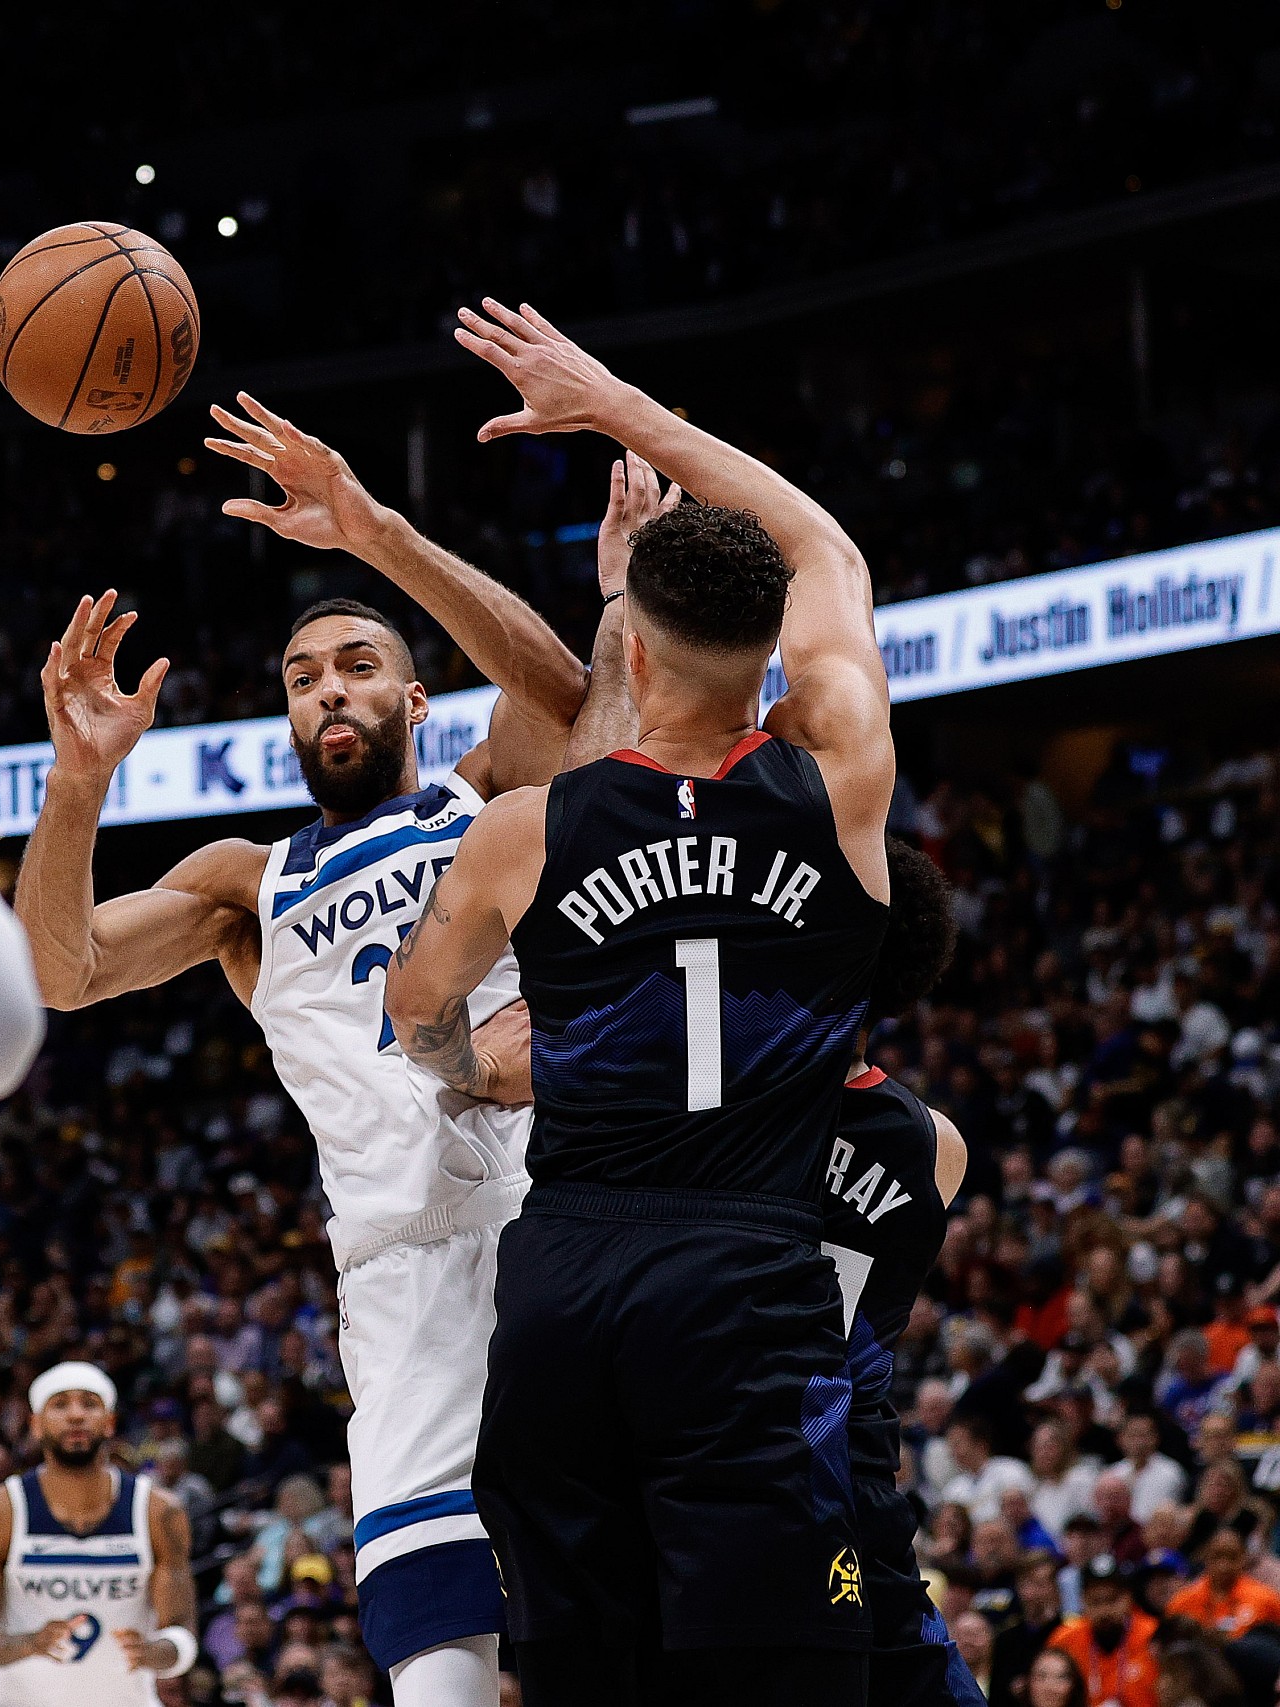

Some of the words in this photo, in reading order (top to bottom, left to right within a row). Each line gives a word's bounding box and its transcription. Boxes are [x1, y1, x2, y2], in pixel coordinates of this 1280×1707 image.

[980, 602, 1089, 663] Justin
[557, 835, 737, 946] PORTER
[750, 850, 822, 928] JR.
[674, 938, 722, 1112] 1
[20, 1576, 139, 1601] WOLVES
[69, 1612, 102, 1662] 9
